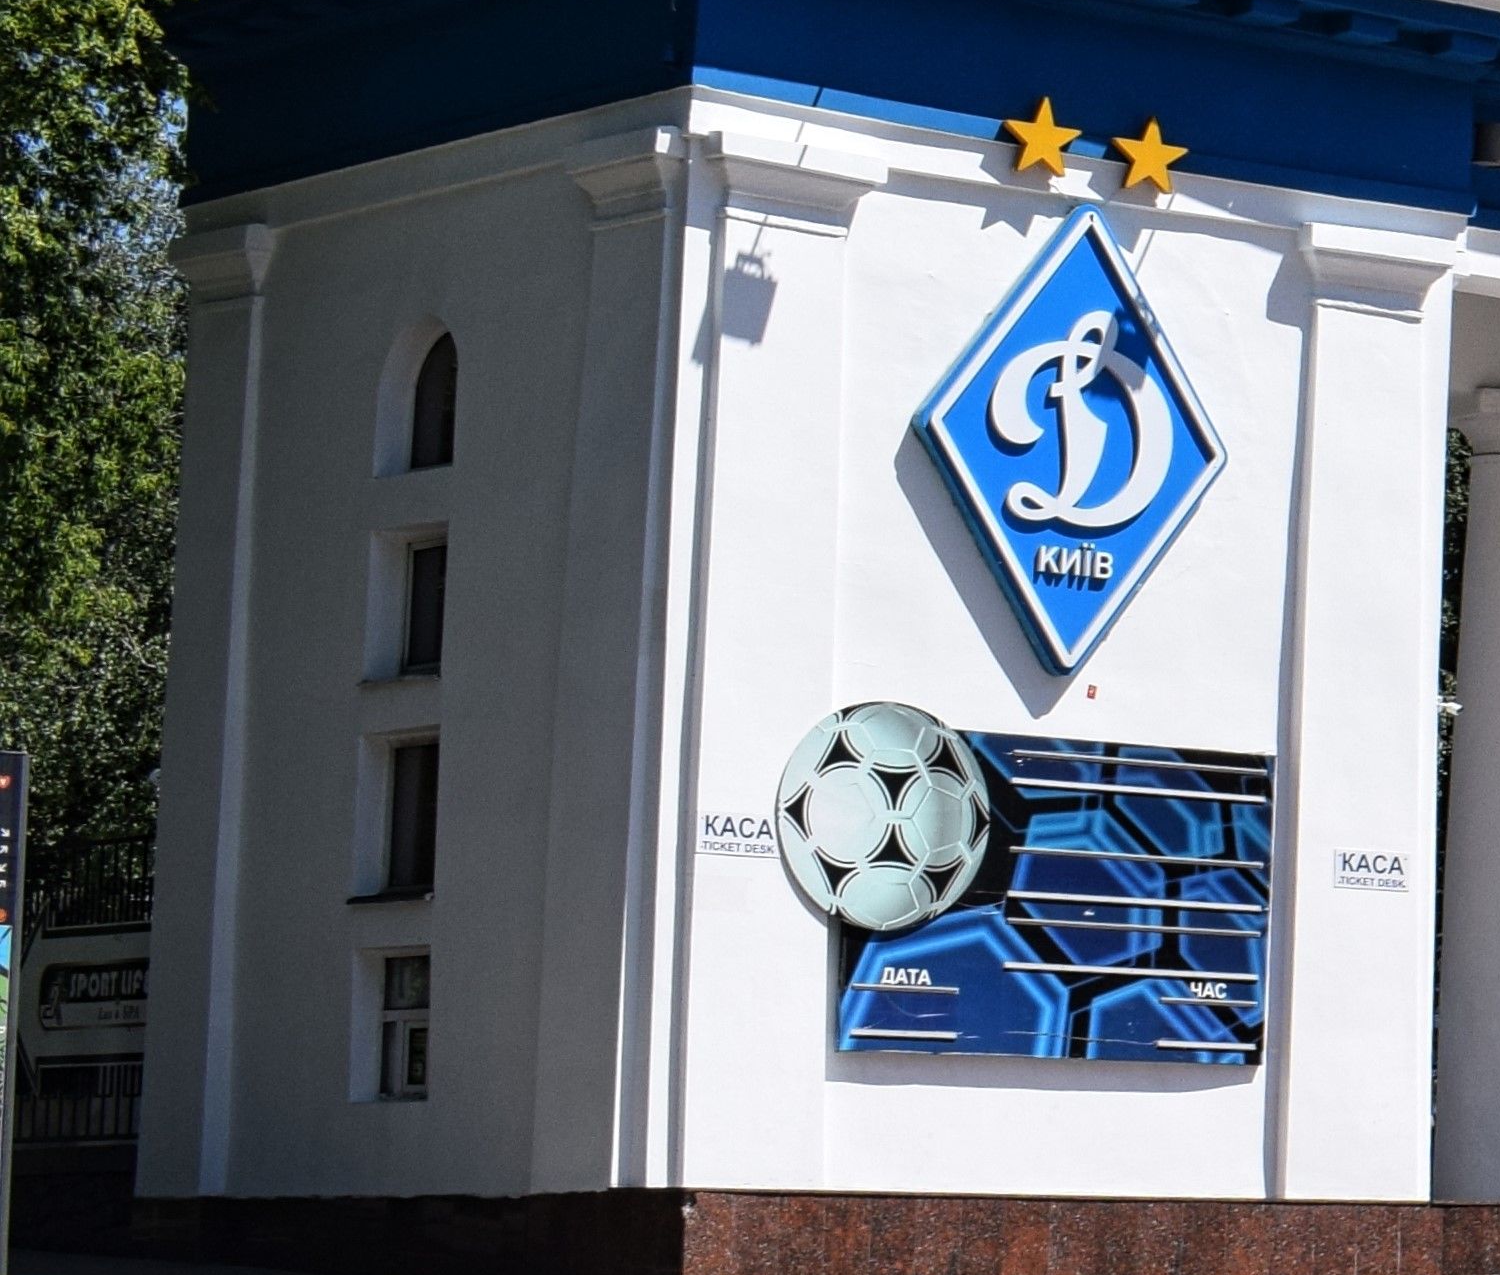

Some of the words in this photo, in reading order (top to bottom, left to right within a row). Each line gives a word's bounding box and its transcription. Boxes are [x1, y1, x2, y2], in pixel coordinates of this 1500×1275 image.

[1037, 541, 1114, 580] КИЇВ
[704, 814, 774, 840] КАСА
[702, 840, 741, 853] TICKET
[744, 843, 775, 855] DESK
[1341, 851, 1405, 876] КАСА
[1339, 876, 1375, 887] TICKET
[1377, 878, 1405, 889] DESK
[69, 972, 119, 999] SPORT
[880, 966, 933, 986] ДАТА
[1190, 981, 1228, 999] ЧАС
